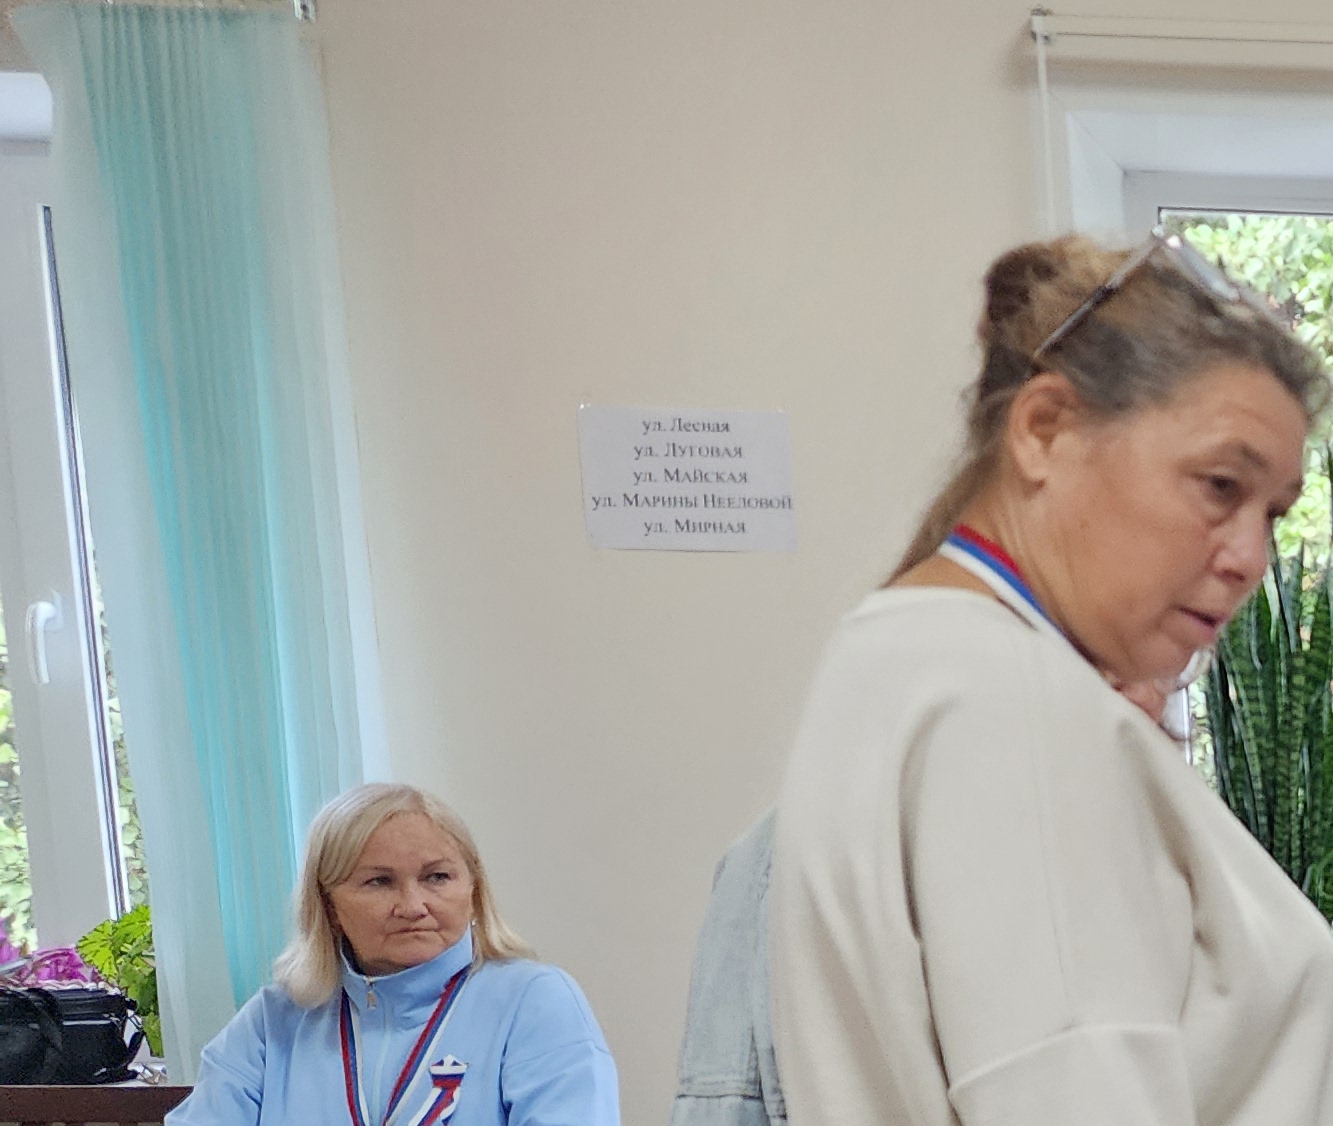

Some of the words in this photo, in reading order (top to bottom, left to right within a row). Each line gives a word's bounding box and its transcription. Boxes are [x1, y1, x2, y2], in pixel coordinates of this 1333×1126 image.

[642, 419, 667, 436] ул.
[670, 417, 731, 433] Лесная
[633, 443, 658, 461] ул.
[664, 442, 744, 459] ЛУГОВАЯ
[633, 469, 658, 486] ул.
[663, 467, 749, 484] МАЙСКАЯ
[591, 494, 618, 511] ул.
[622, 492, 699, 509] МАРИНЫ
[702, 493, 793, 510] НЕЕЛОВОЙ
[643, 520, 668, 537] ул.
[674, 518, 747, 534] МИРНАЯ
